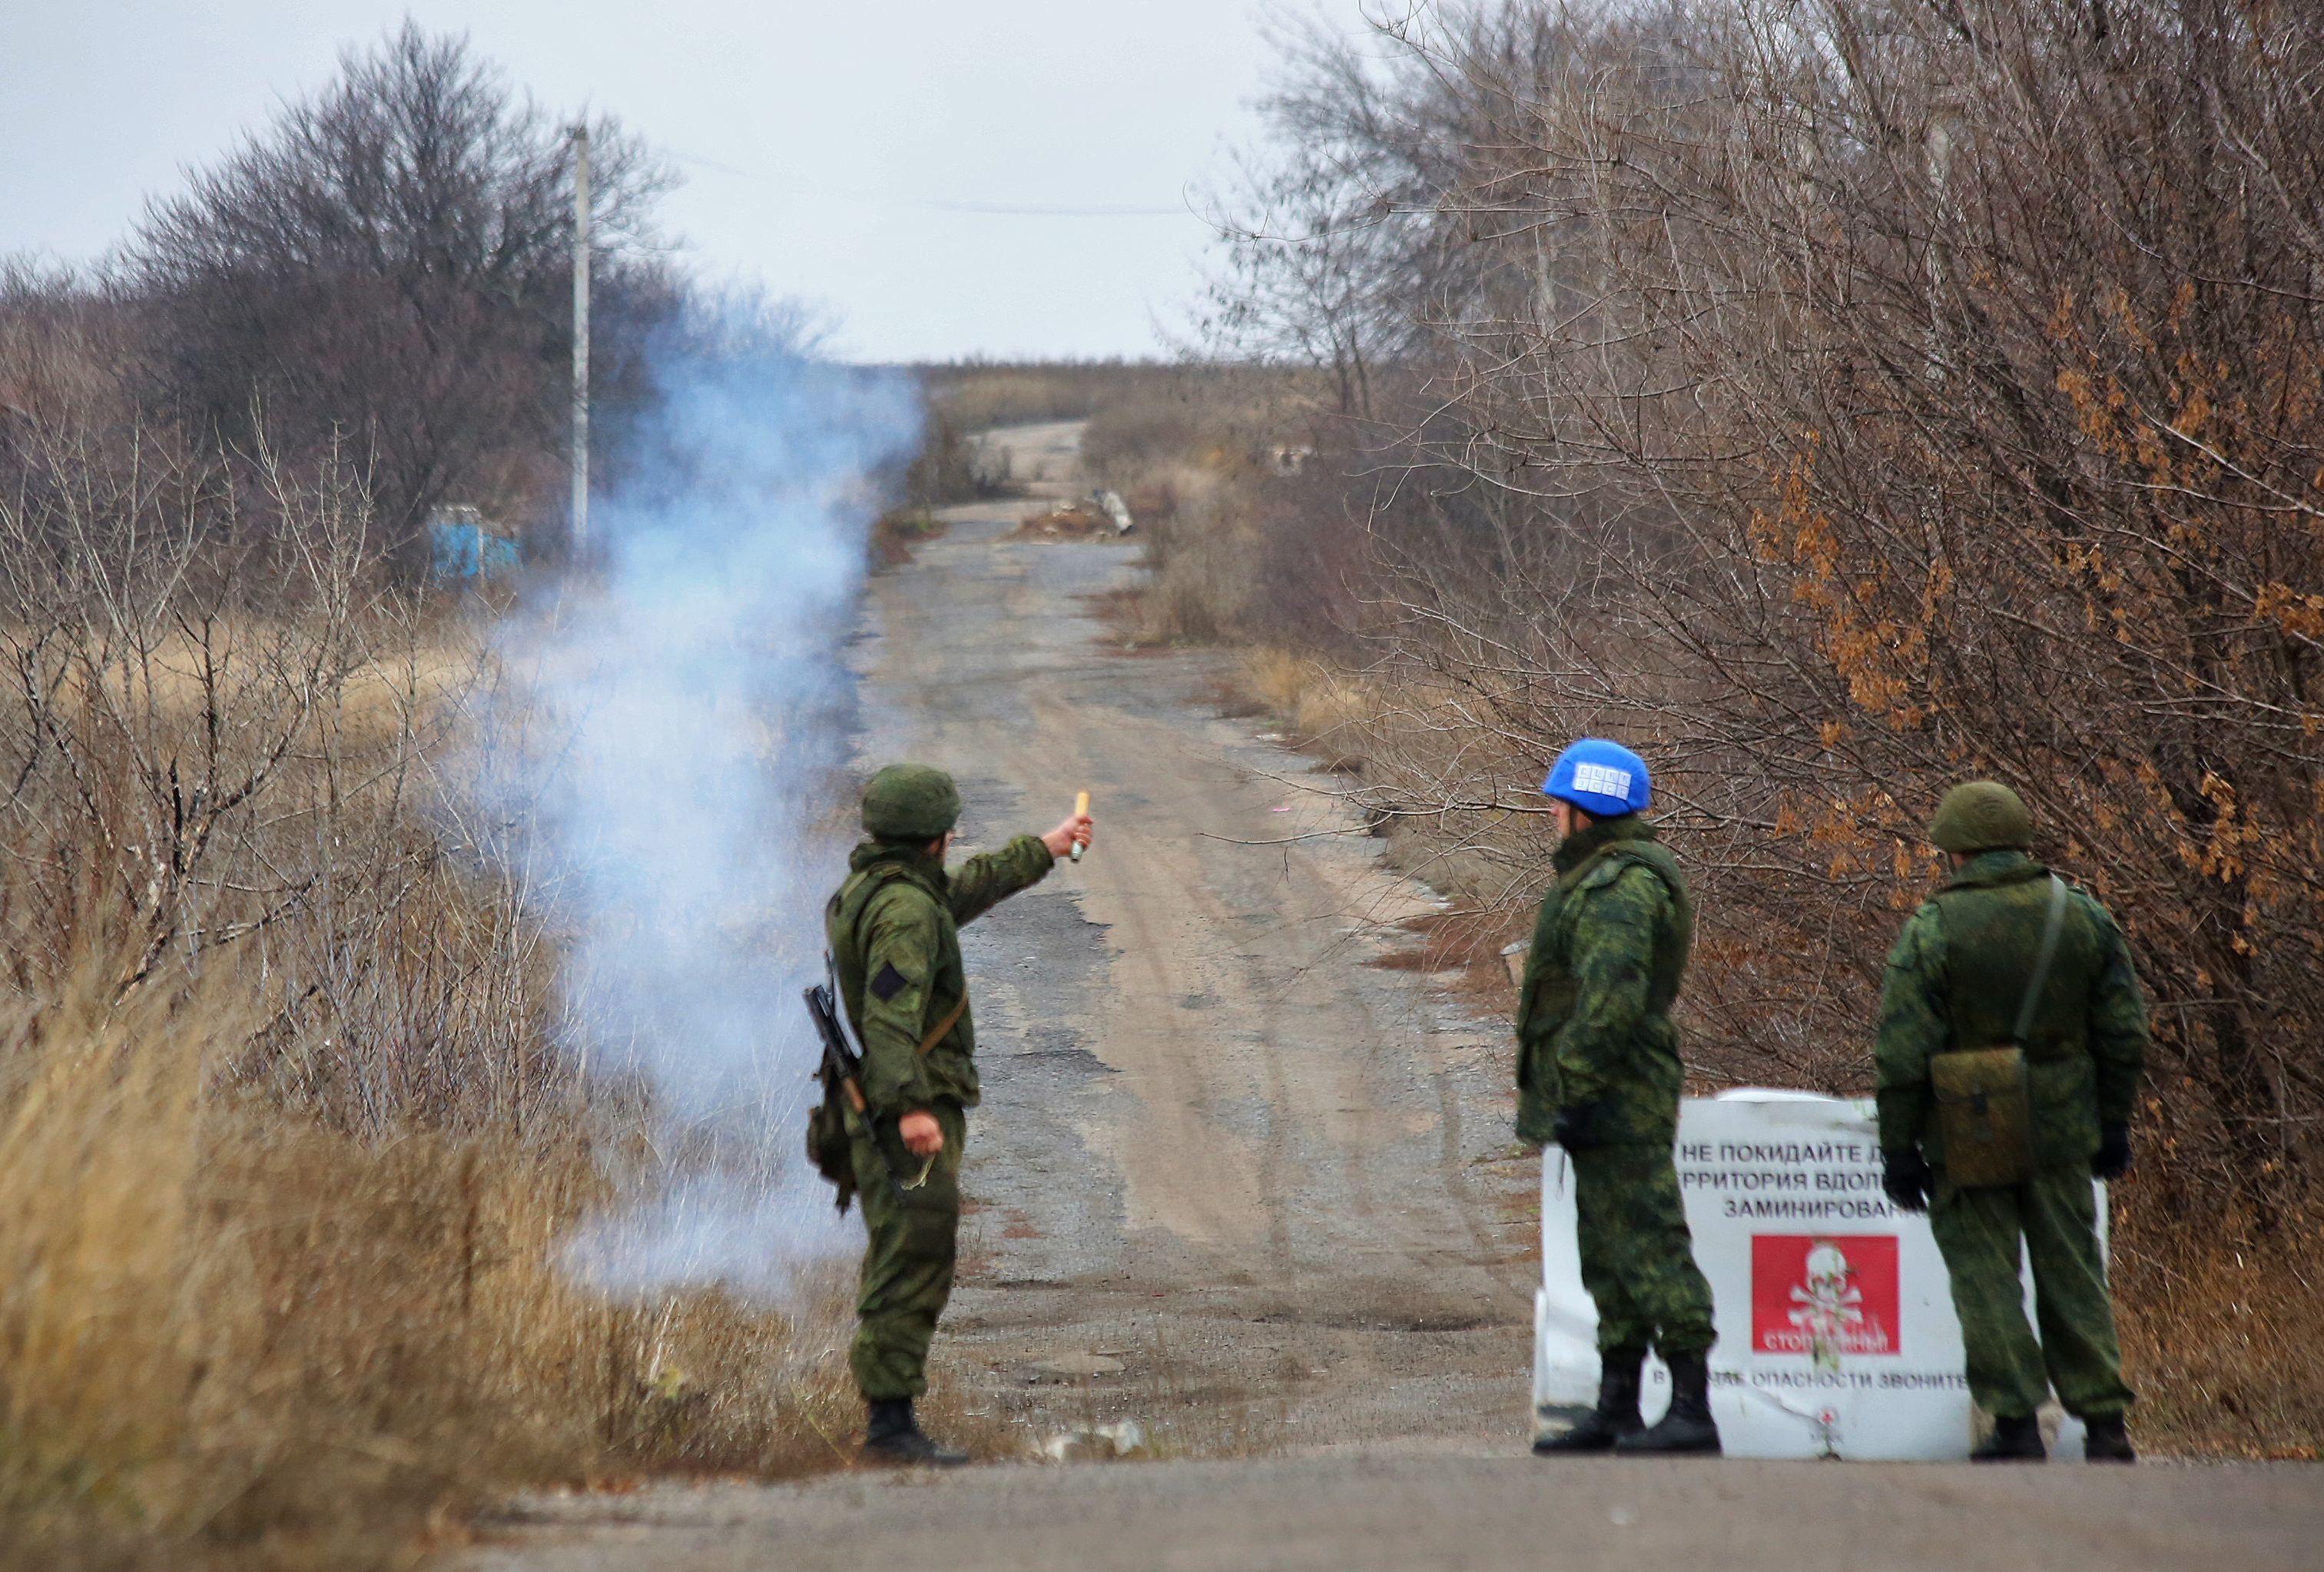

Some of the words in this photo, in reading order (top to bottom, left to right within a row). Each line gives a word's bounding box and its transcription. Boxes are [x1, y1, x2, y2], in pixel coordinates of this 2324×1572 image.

[1682, 1144, 1712, 1162] НЕ
[1721, 1142, 1862, 1165] ПОКИДАЙТЕ
[1682, 1172, 1807, 1189] РРИТОРИЯ
[1816, 1172, 1885, 1192] ВДОЛ
[1725, 1200, 1919, 1217] ЗАМИНИРОВА
[1653, 1371, 1665, 1383] В
[1752, 1371, 1872, 1388] ОПАСНОСТИ
